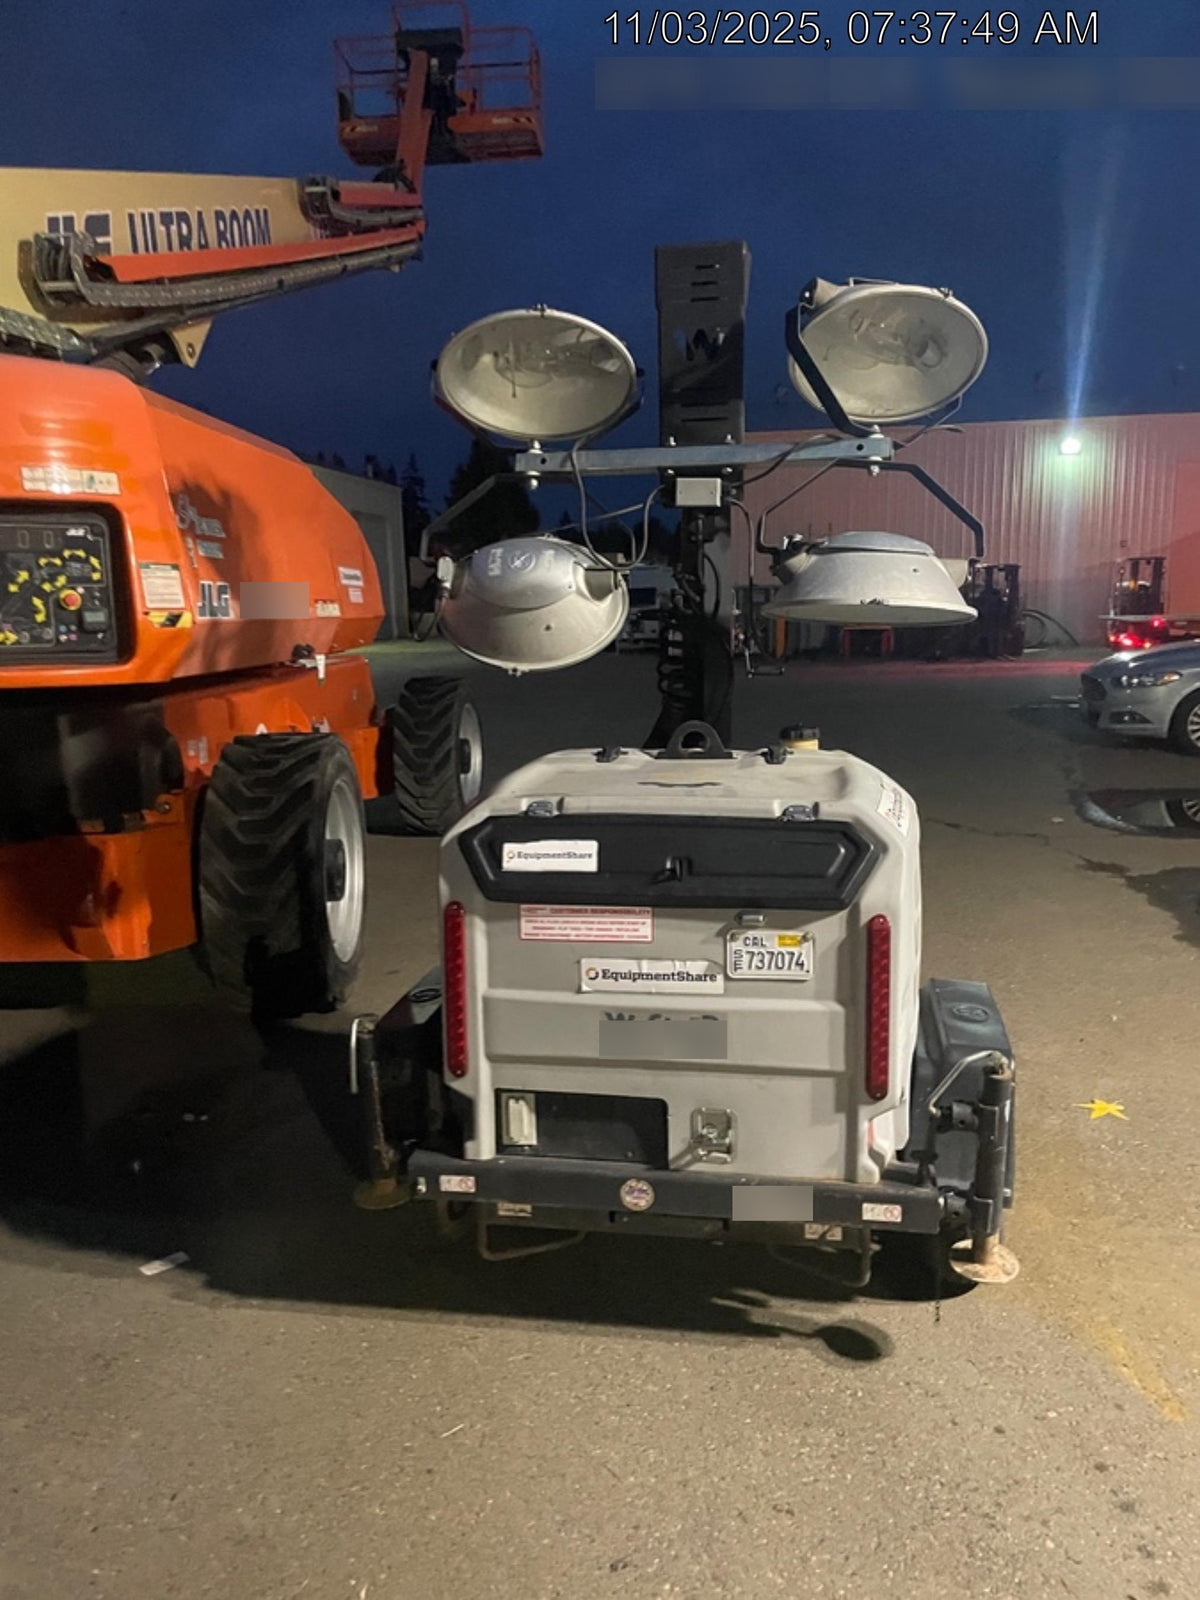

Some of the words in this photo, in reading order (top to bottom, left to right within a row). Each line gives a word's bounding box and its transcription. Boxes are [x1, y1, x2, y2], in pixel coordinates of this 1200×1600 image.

[129, 210, 209, 253] ULTRA
[214, 208, 272, 249] BOOM
[197, 580, 233, 618] JLG
[517, 850, 593, 861] EquipmentShare
[743, 936, 767, 948] CAL
[745, 950, 805, 971] 737074
[602, 968, 717, 983] EquipmentShare
